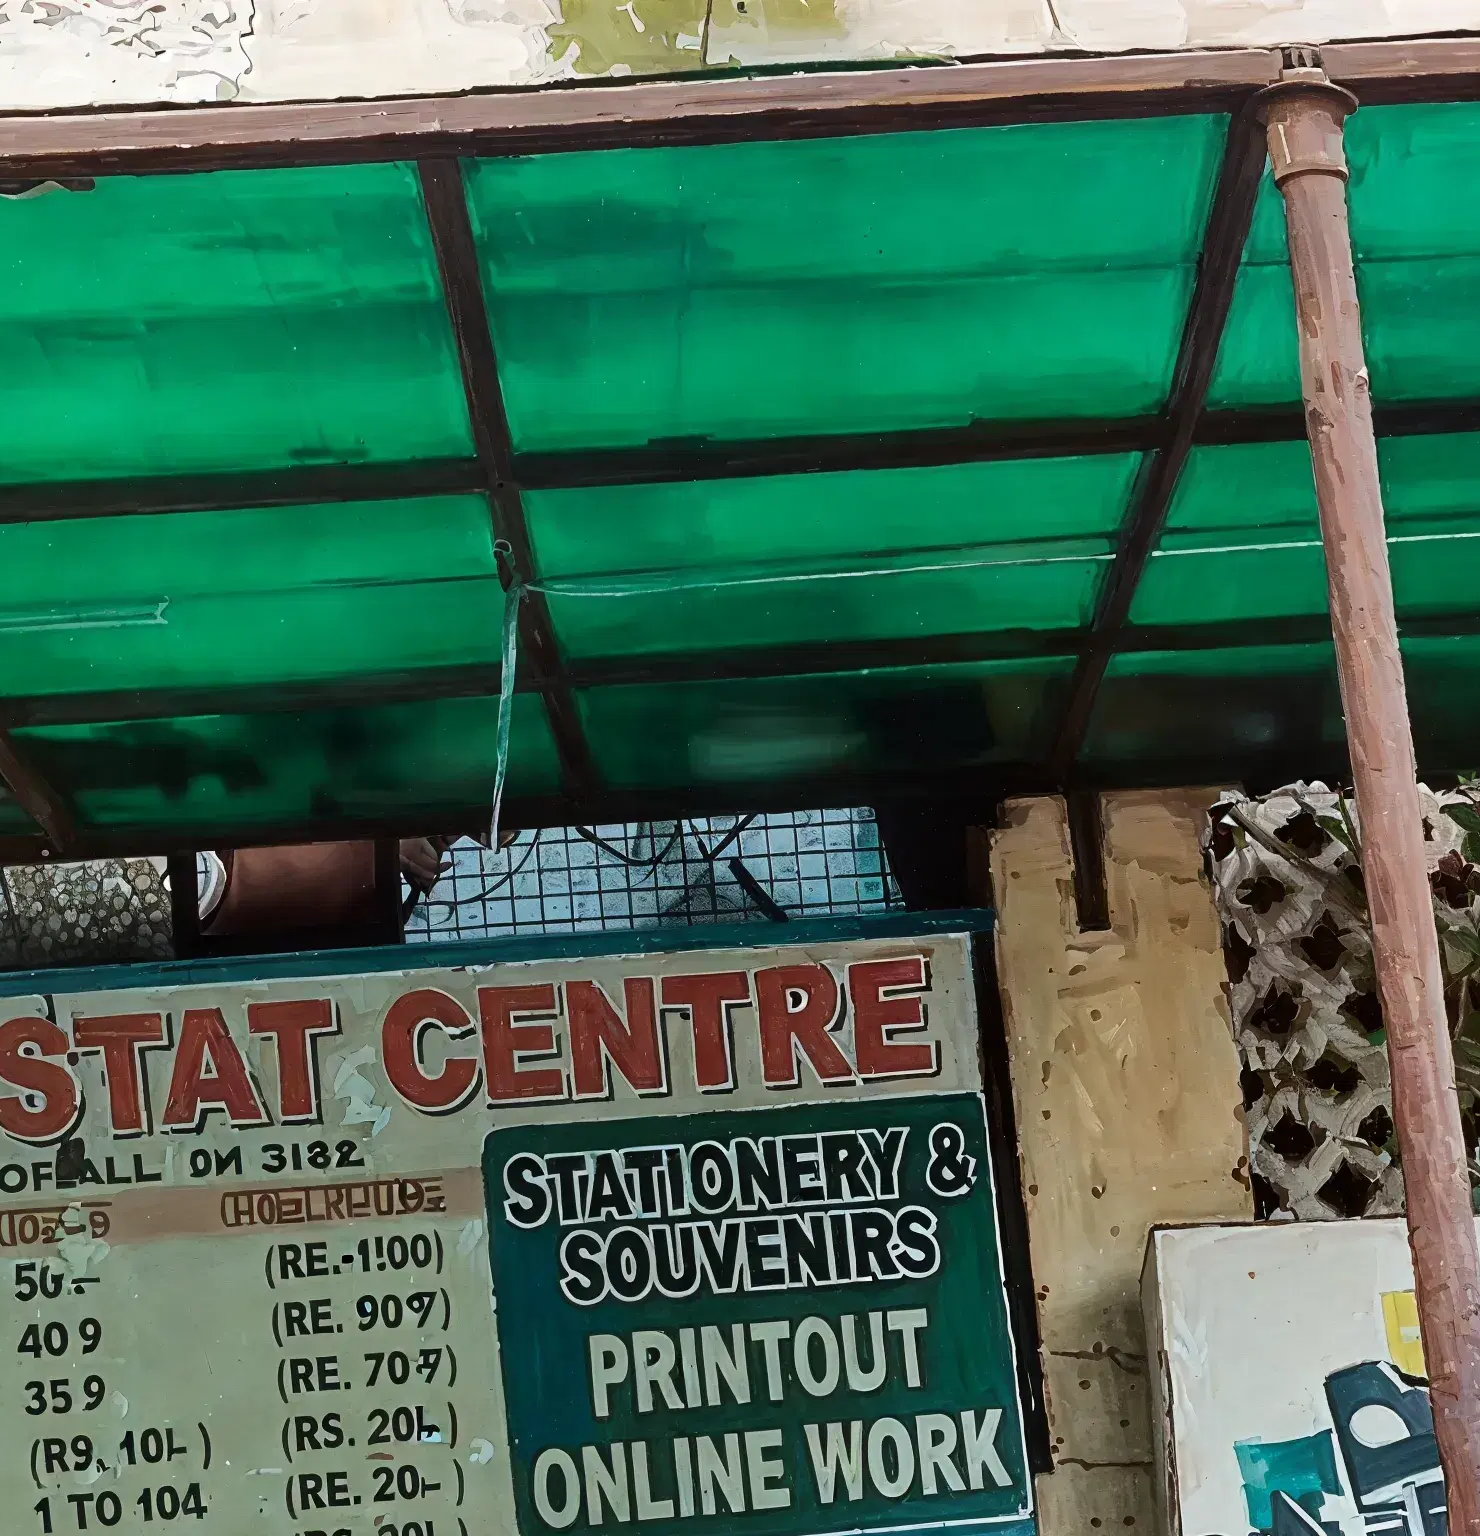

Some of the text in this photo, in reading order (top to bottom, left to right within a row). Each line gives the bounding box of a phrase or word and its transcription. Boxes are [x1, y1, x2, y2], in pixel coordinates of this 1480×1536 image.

[381, 954, 941, 1115] CENTRE
[78, 1153, 163, 1185] ALL
[503, 1126, 911, 1229] STATIONERY
[926, 1122, 977, 1198] &
[559, 1204, 941, 1307] SOUVENIRS
[588, 1307, 930, 1420] PRINTOUT
[33, 1482, 208, 1534] 1 TO 104
[532, 1406, 1015, 1530] ONLINE WORK
